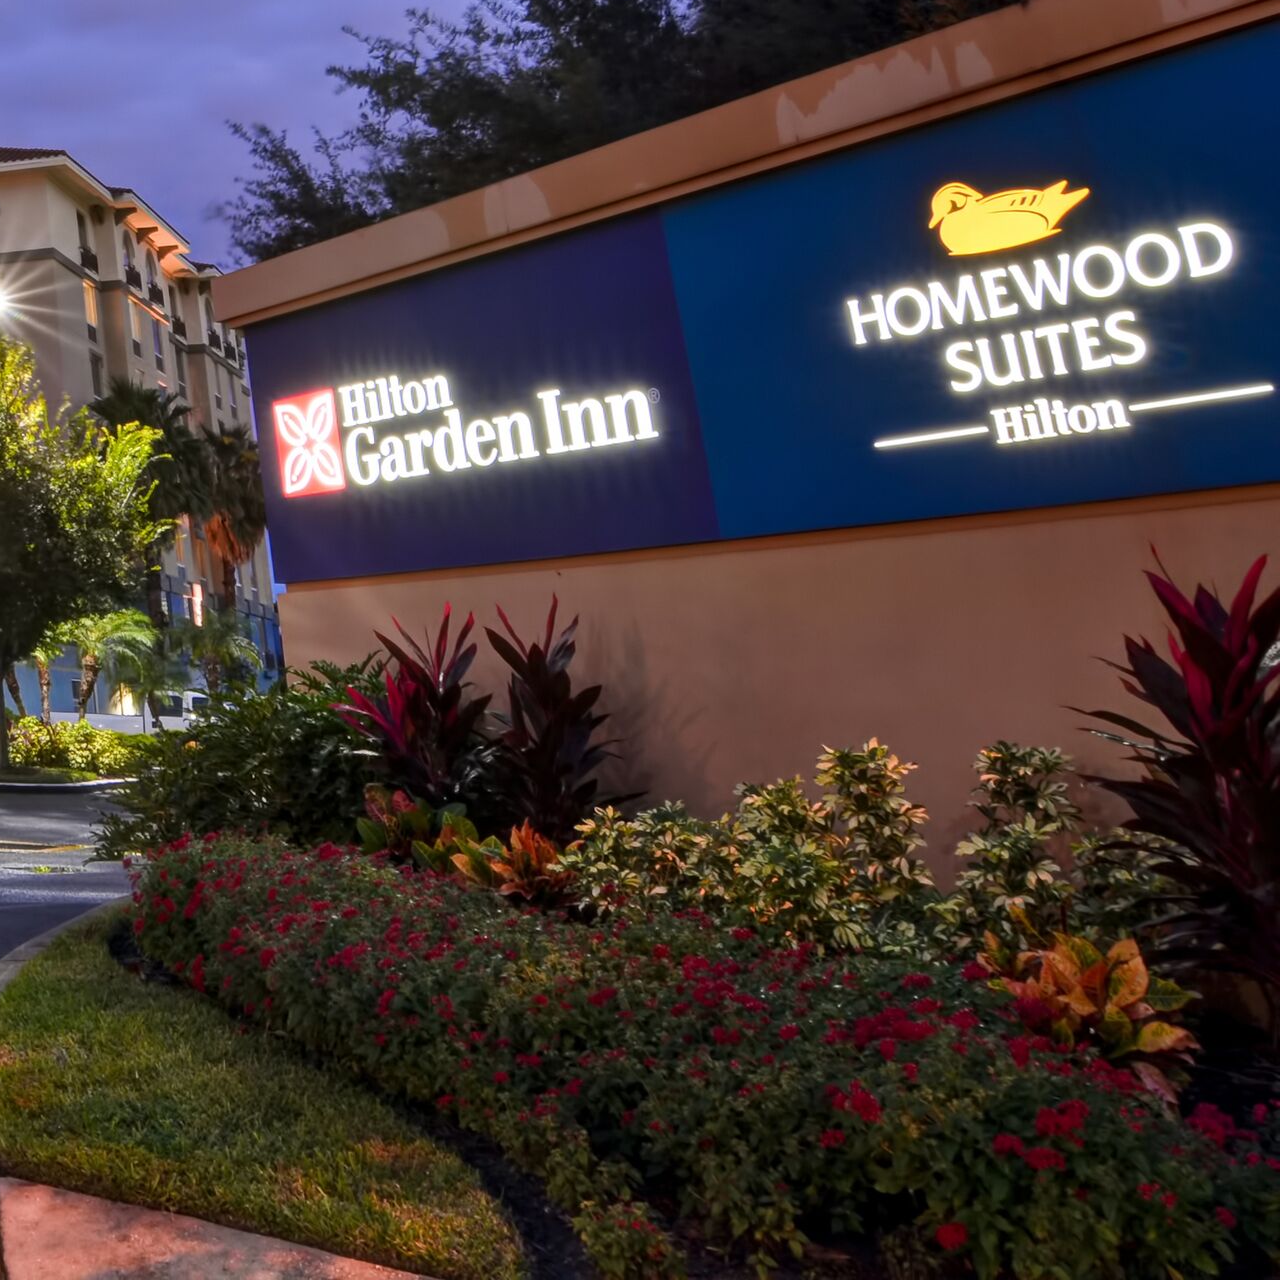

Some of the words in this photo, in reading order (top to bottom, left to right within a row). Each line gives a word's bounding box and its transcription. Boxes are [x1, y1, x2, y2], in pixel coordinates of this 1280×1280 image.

[846, 222, 1234, 345] HOMEWOOD
[945, 311, 1147, 392] SUITES
[338, 375, 454, 428] Hilton
[344, 407, 539, 487] Garden
[537, 386, 659, 456] Inn
[990, 398, 1132, 445] Hilton
